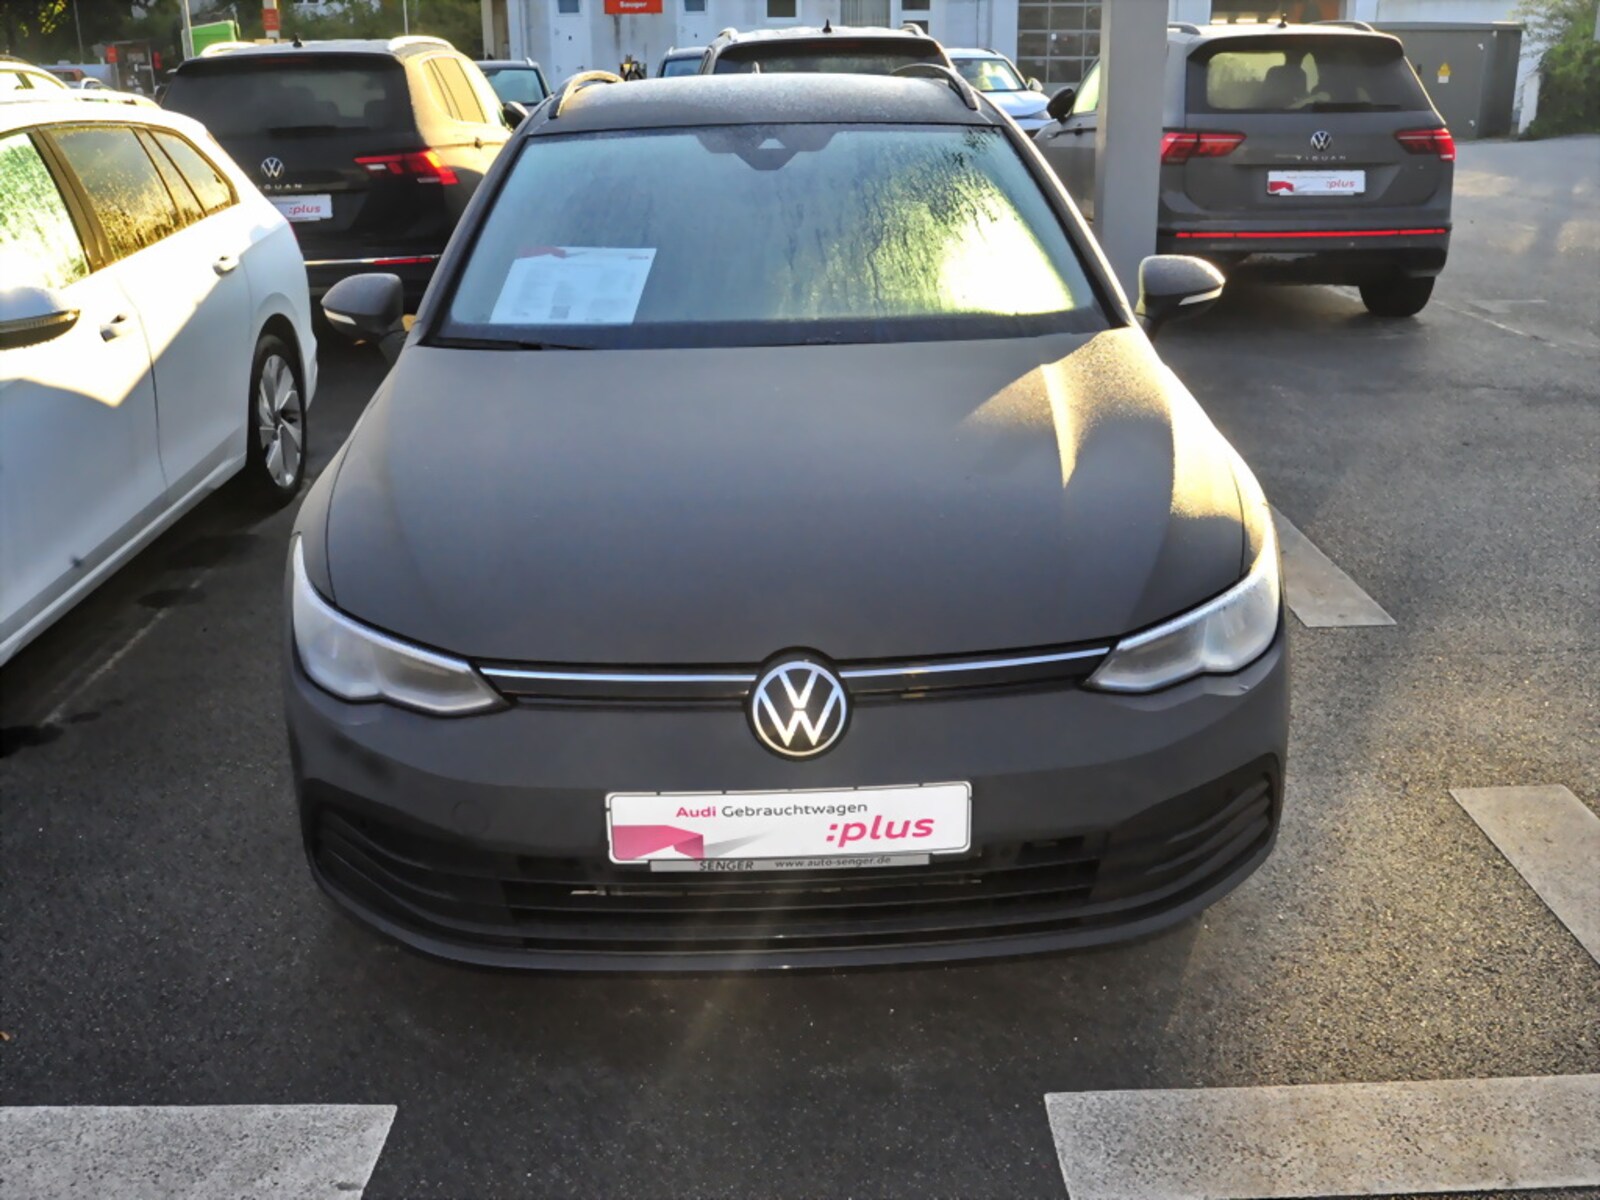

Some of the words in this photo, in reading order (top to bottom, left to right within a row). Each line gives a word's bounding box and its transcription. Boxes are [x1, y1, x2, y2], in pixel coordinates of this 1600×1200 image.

[755, 663, 844, 751] VW
[676, 806, 717, 818] Audi
[721, 803, 868, 818] Gebrauchtwagen
[826, 814, 935, 848] :plus
[699, 860, 754, 872] SENGER
[774, 855, 892, 868] www.auto-senger.de
